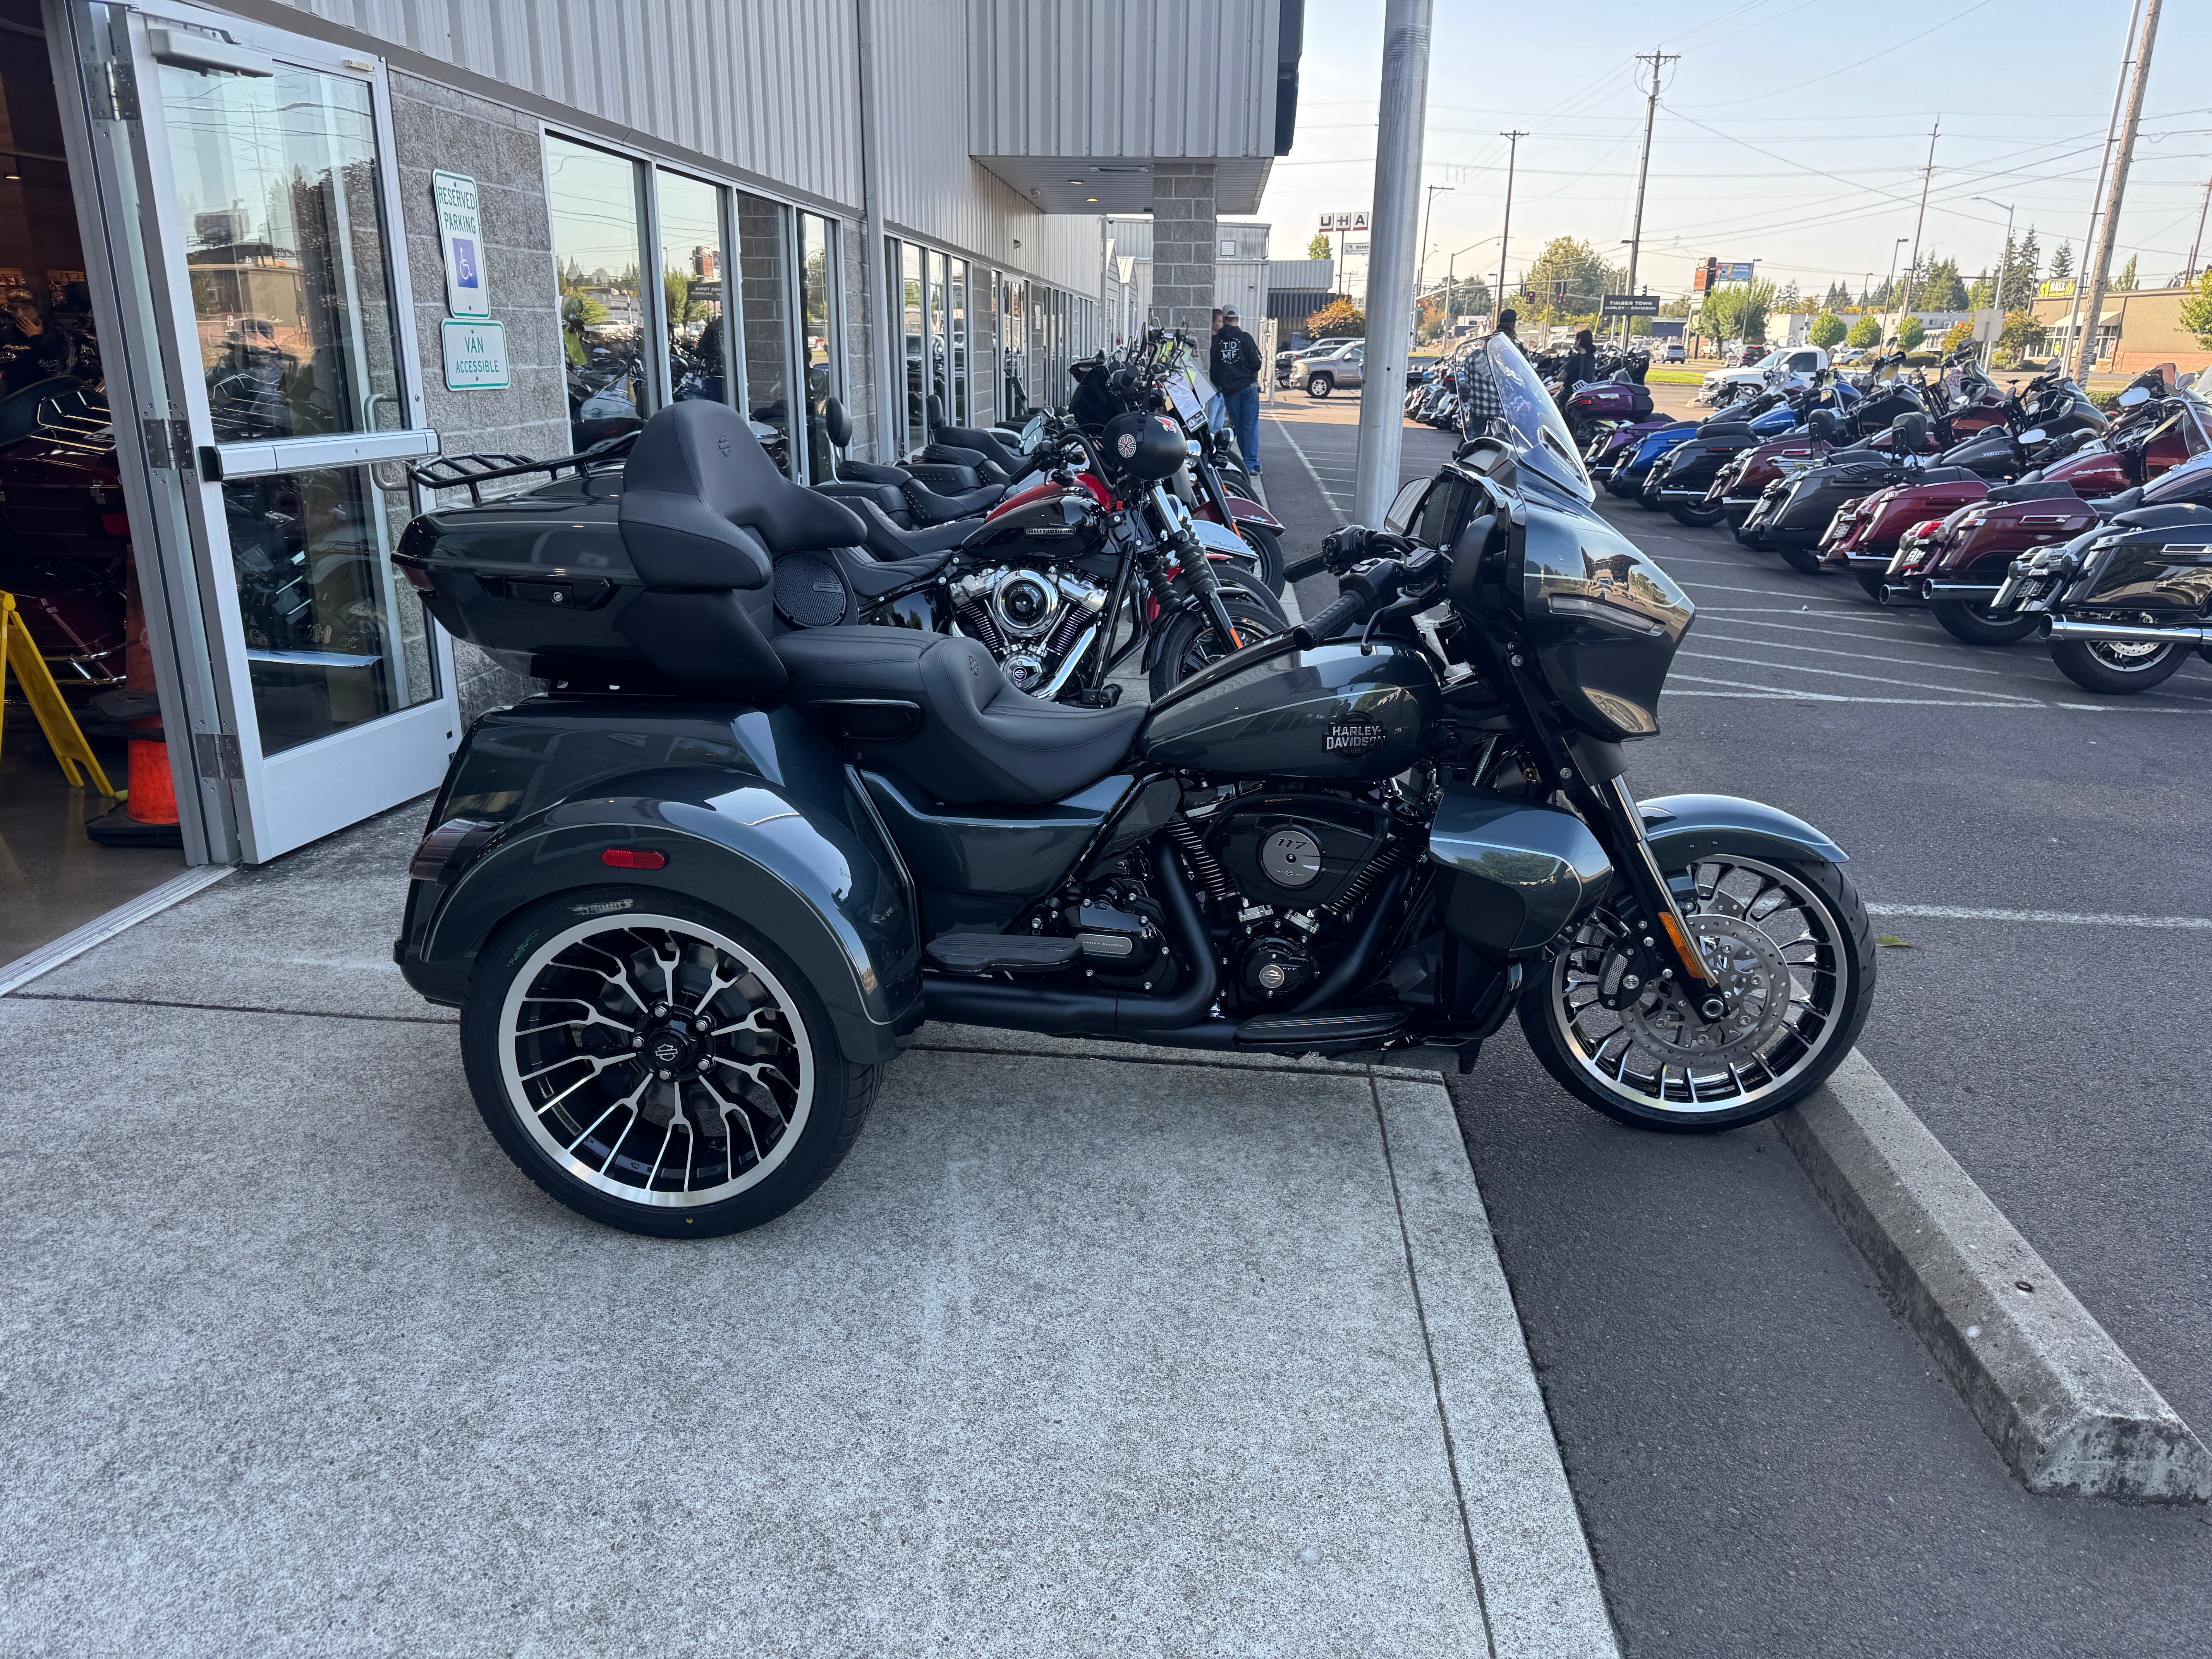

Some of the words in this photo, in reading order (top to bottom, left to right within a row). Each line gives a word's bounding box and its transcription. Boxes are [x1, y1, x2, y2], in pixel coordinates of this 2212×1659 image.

[438, 186, 475, 210] RESERVED
[444, 212, 476, 234] PARKING
[464, 337, 484, 353] VAN
[456, 360, 499, 373] ACCESSIBLE
[1333, 726, 1381, 736] HARLEY-
[1326, 736, 1386, 750] DAVIDSON
[1276, 838, 1309, 850] 117
